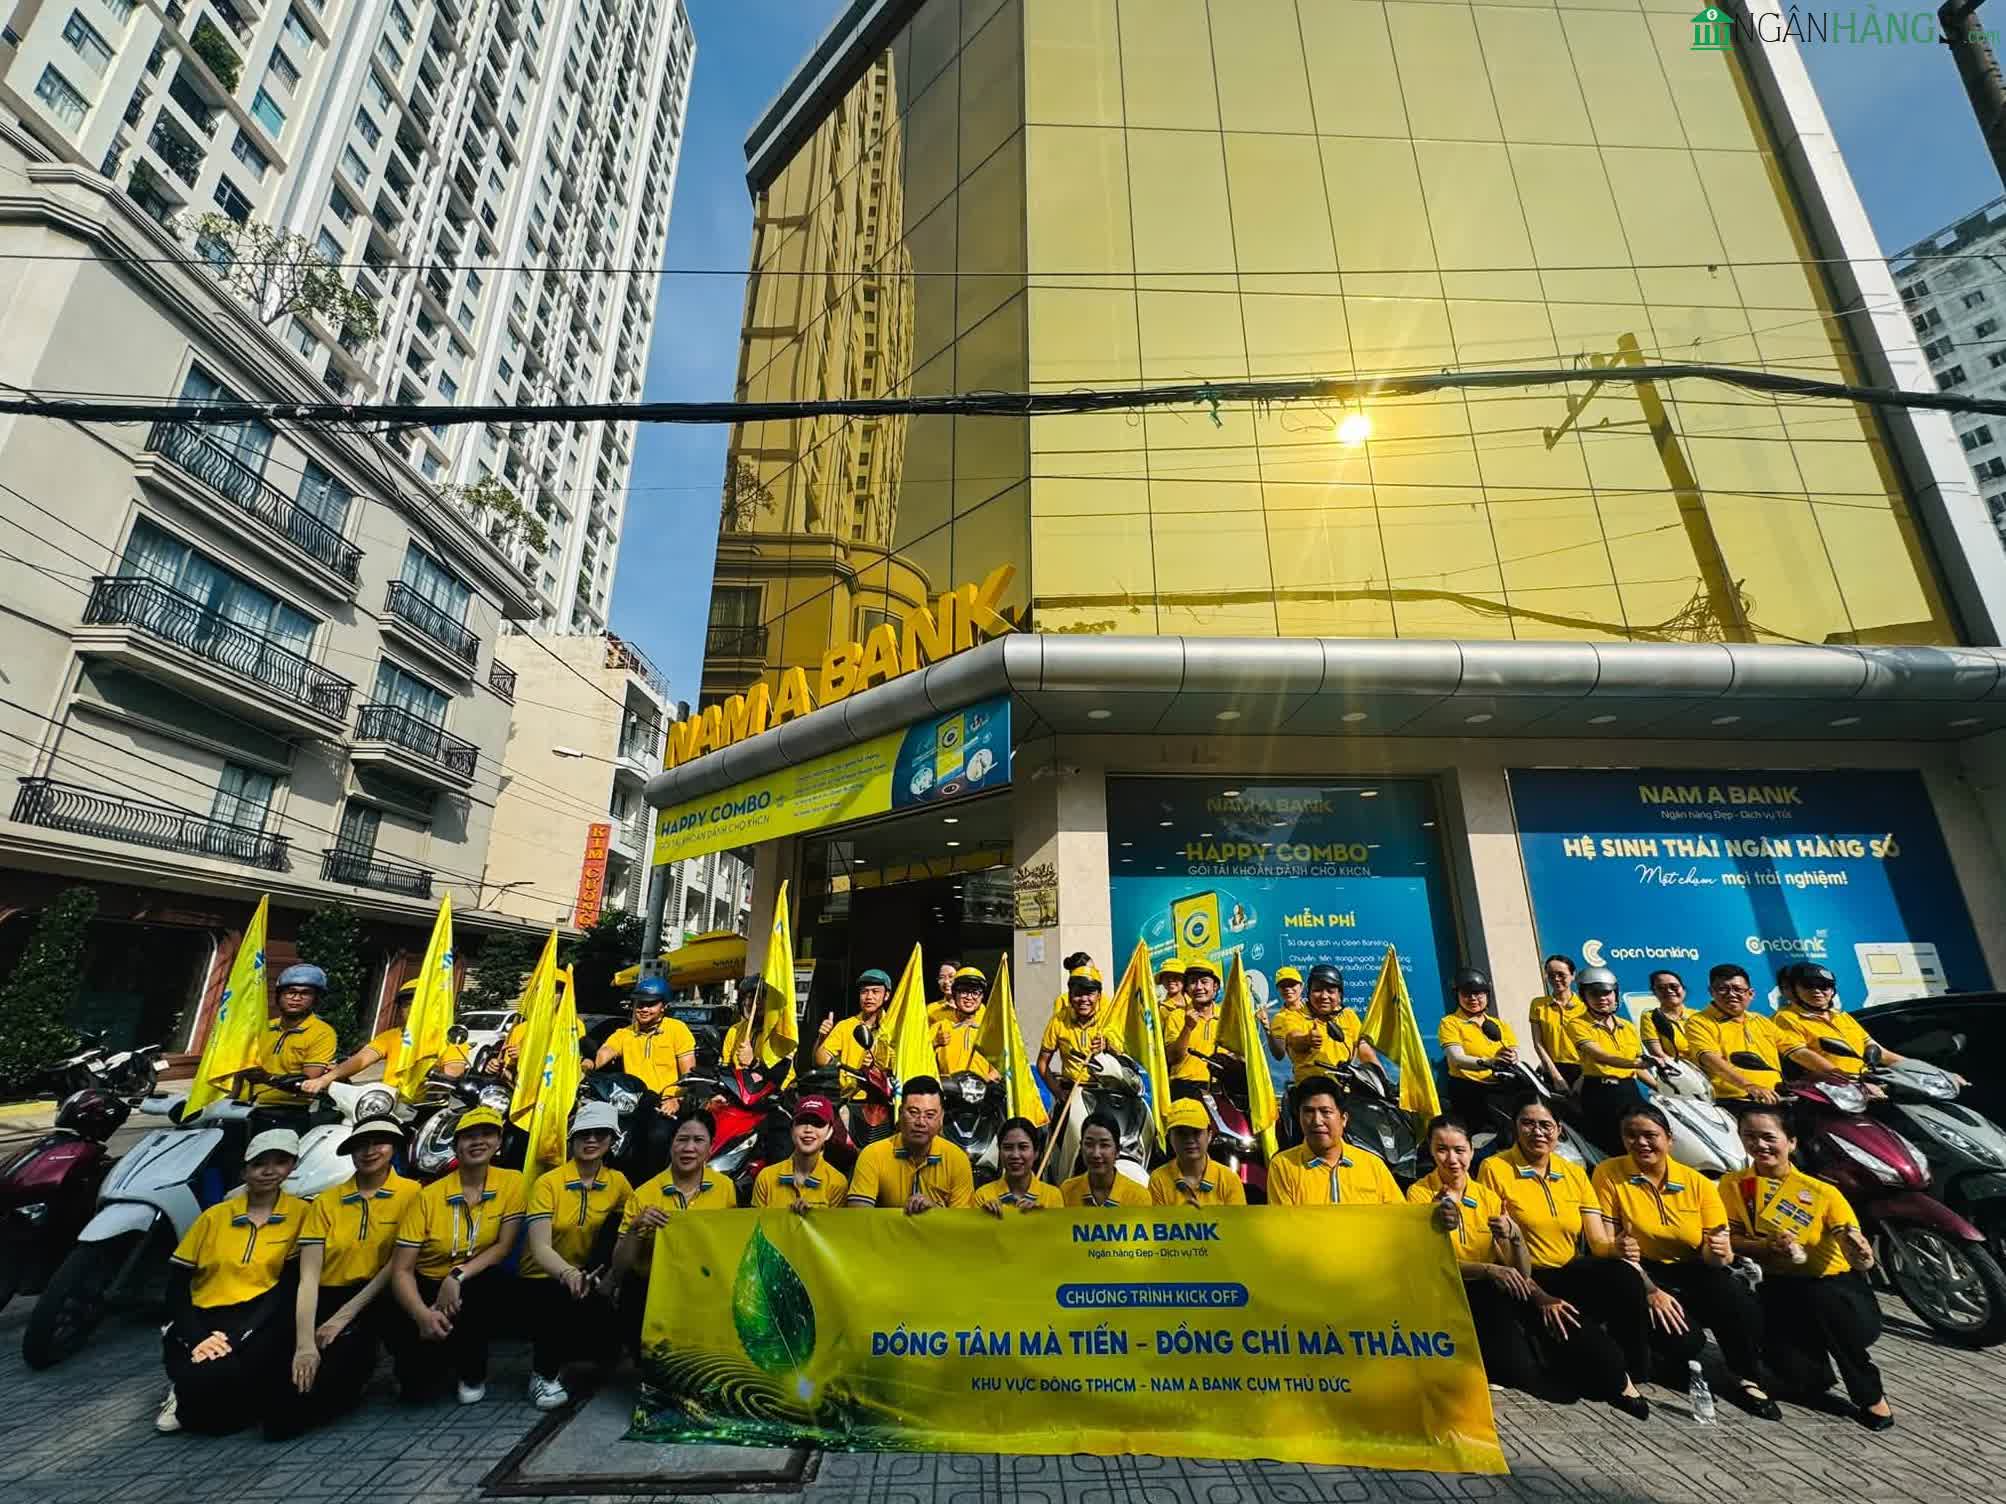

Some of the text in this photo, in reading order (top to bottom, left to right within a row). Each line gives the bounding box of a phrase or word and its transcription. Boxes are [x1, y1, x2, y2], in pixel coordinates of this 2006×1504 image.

[665, 563, 1017, 770] NAM A BANK
[1639, 786, 1803, 805] NAM A BANK
[661, 791, 771, 837] HAPPY COMBO
[586, 827, 608, 859] KIM
[1185, 843, 1368, 862] HAPPY COMBO
[1563, 833, 1900, 860] HỆ SINH THÁI NGÂN HÀNG SỐ
[1311, 865, 1336, 875] CHO
[1339, 865, 1370, 876] KHCN
[1722, 872, 1750, 889] mọi
[1754, 870, 1781, 886] trải
[1784, 869, 1848, 889] nghiệm!
[1284, 907, 1356, 927] MIỄN PHÍ
[1611, 946, 1699, 961] open banking
[1072, 1222, 1220, 1242] NAM A BANK
[1088, 1248, 1111, 1259] Ngân
[1112, 1248, 1134, 1259] hàng
[1136, 1248, 1153, 1259] Đẹp
[1160, 1248, 1180, 1258] Dịch
[1181, 1250, 1193, 1259] vụ
[1193, 1247, 1208, 1257] Tốt
[1066, 1286, 1239, 1304] CHƯƠNG TRÌNH KICK OFF
[872, 1322, 948, 1356] ĐỒNG
[955, 1325, 1011, 1356] TÂM
[1020, 1325, 1062, 1356] MÀ
[1069, 1321, 1128, 1355] TIẾN
[1156, 1320, 1233, 1355] ĐỒNG
[1241, 1324, 1289, 1355] CHÍ
[1298, 1323, 1344, 1356] MÀ
[1349, 1320, 1455, 1358] THẮNG
[972, 1377, 1001, 1391] KHU
[1005, 1377, 1035, 1395] VỰC
[1040, 1376, 1082, 1392] ĐÔNG
[1085, 1378, 1136, 1392] TPHCM
[1151, 1377, 1184, 1392] NAM
[1188, 1377, 1199, 1391] A
[1202, 1377, 1241, 1391] BANK
[1247, 1377, 1281, 1395] CỤM
[1284, 1373, 1314, 1392] THỦ
[1319, 1375, 1351, 1393] ĐỨC
